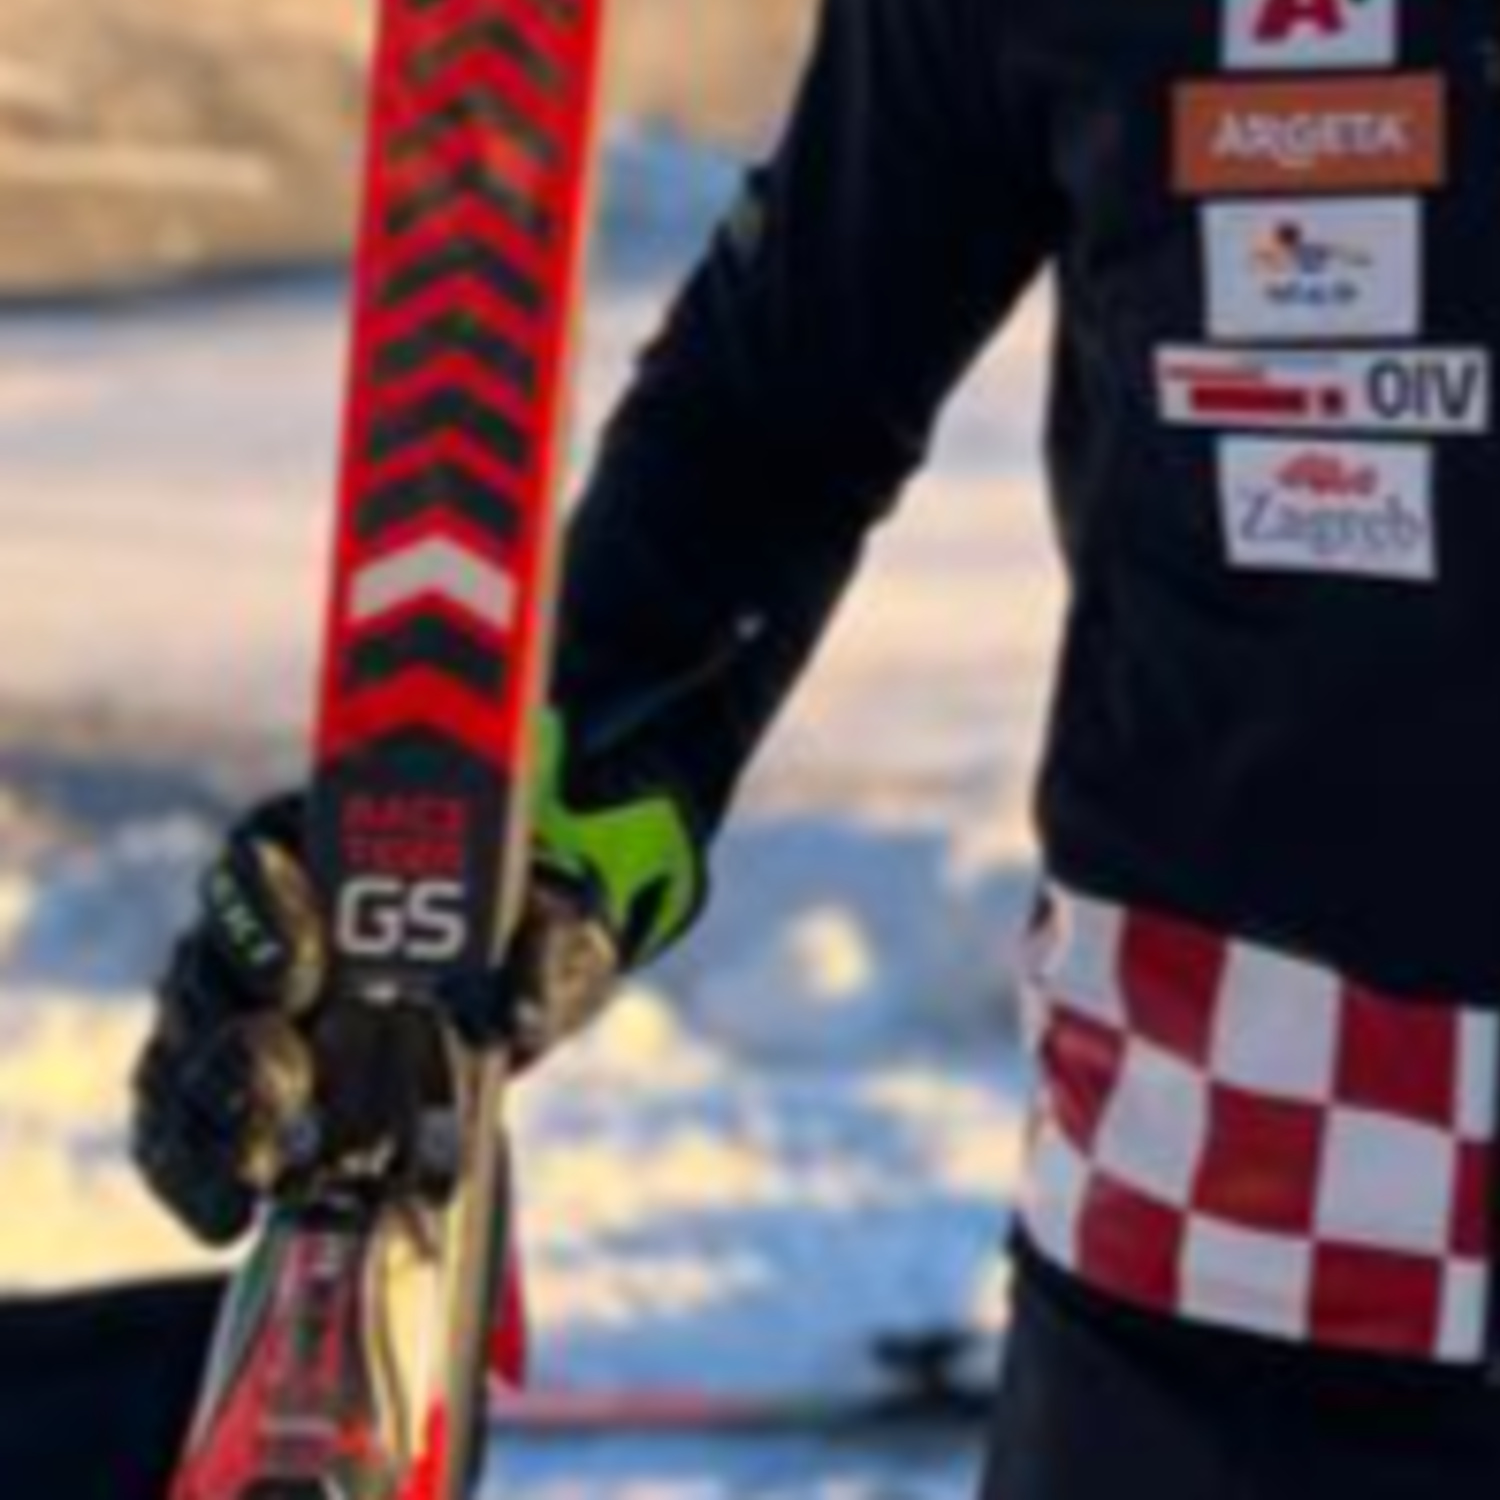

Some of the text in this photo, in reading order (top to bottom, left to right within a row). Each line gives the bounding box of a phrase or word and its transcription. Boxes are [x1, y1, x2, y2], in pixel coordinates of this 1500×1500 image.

[1211, 112, 1411, 168] ARGETA
[1366, 358, 1478, 420] OIV
[1238, 490, 1427, 560] Zagreb
[336, 878, 465, 959] GS
